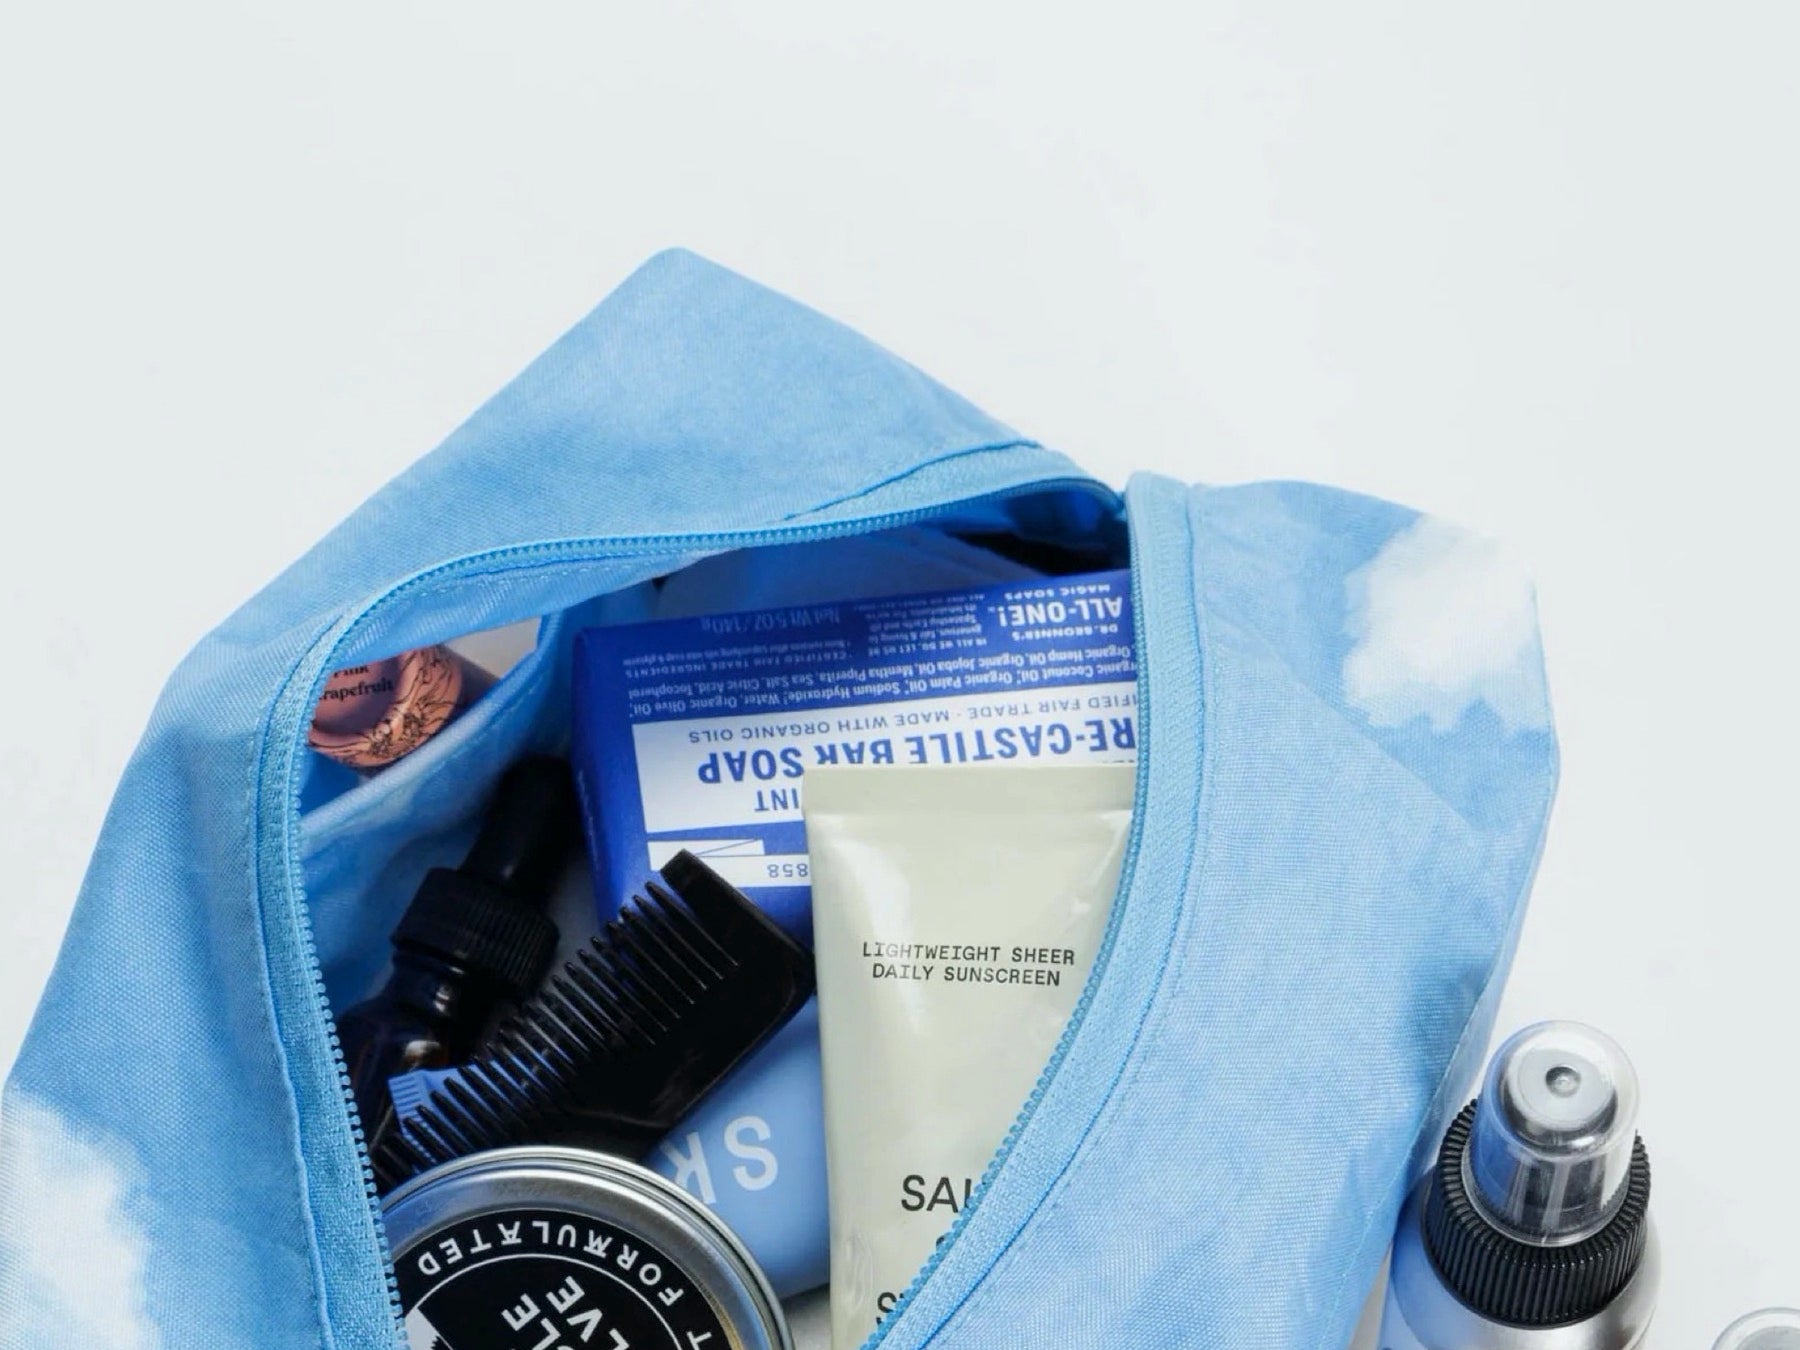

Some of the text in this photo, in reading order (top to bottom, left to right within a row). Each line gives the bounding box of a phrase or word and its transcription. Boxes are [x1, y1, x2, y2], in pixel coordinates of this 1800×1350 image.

[1004, 584, 1110, 600] MAGIC SOAPS
[998, 596, 1122, 627] ALL-ONE!
[1012, 625, 1092, 641] BRONNER'S
[1048, 649, 1082, 664] Hemp
[1084, 644, 1130, 661] Organic
[937, 656, 975, 672] Jojoba
[978, 653, 1024, 669] Organic
[1097, 659, 1136, 675] rganic
[868, 664, 913, 679] Mentha
[964, 671, 1012, 687] Organic
[1042, 665, 1094, 679] Coconut
[727, 678, 760, 691] Citric
[792, 674, 813, 686] Sea
[930, 676, 962, 690] Palm
[318, 677, 395, 702] rapefruit
[628, 683, 693, 699] Tocopherol
[853, 682, 900, 697] Sodium
[654, 700, 686, 713] Olive
[690, 694, 737, 710] Organic
[688, 694, 1136, 744] IFIED FAIR TRADE MADE WITH ORGANIC OILS
[904, 716, 1136, 764] RE-CASTILE
[697, 747, 805, 784] SOAP
[753, 787, 799, 812] INT
[766, 863, 808, 879] 858
[862, 941, 1075, 966] LIGHTWEIGHT SHEER
[872, 962, 1061, 987] DAILY SUNSCREEN
[417, 1219, 684, 1307] FORMULATED
